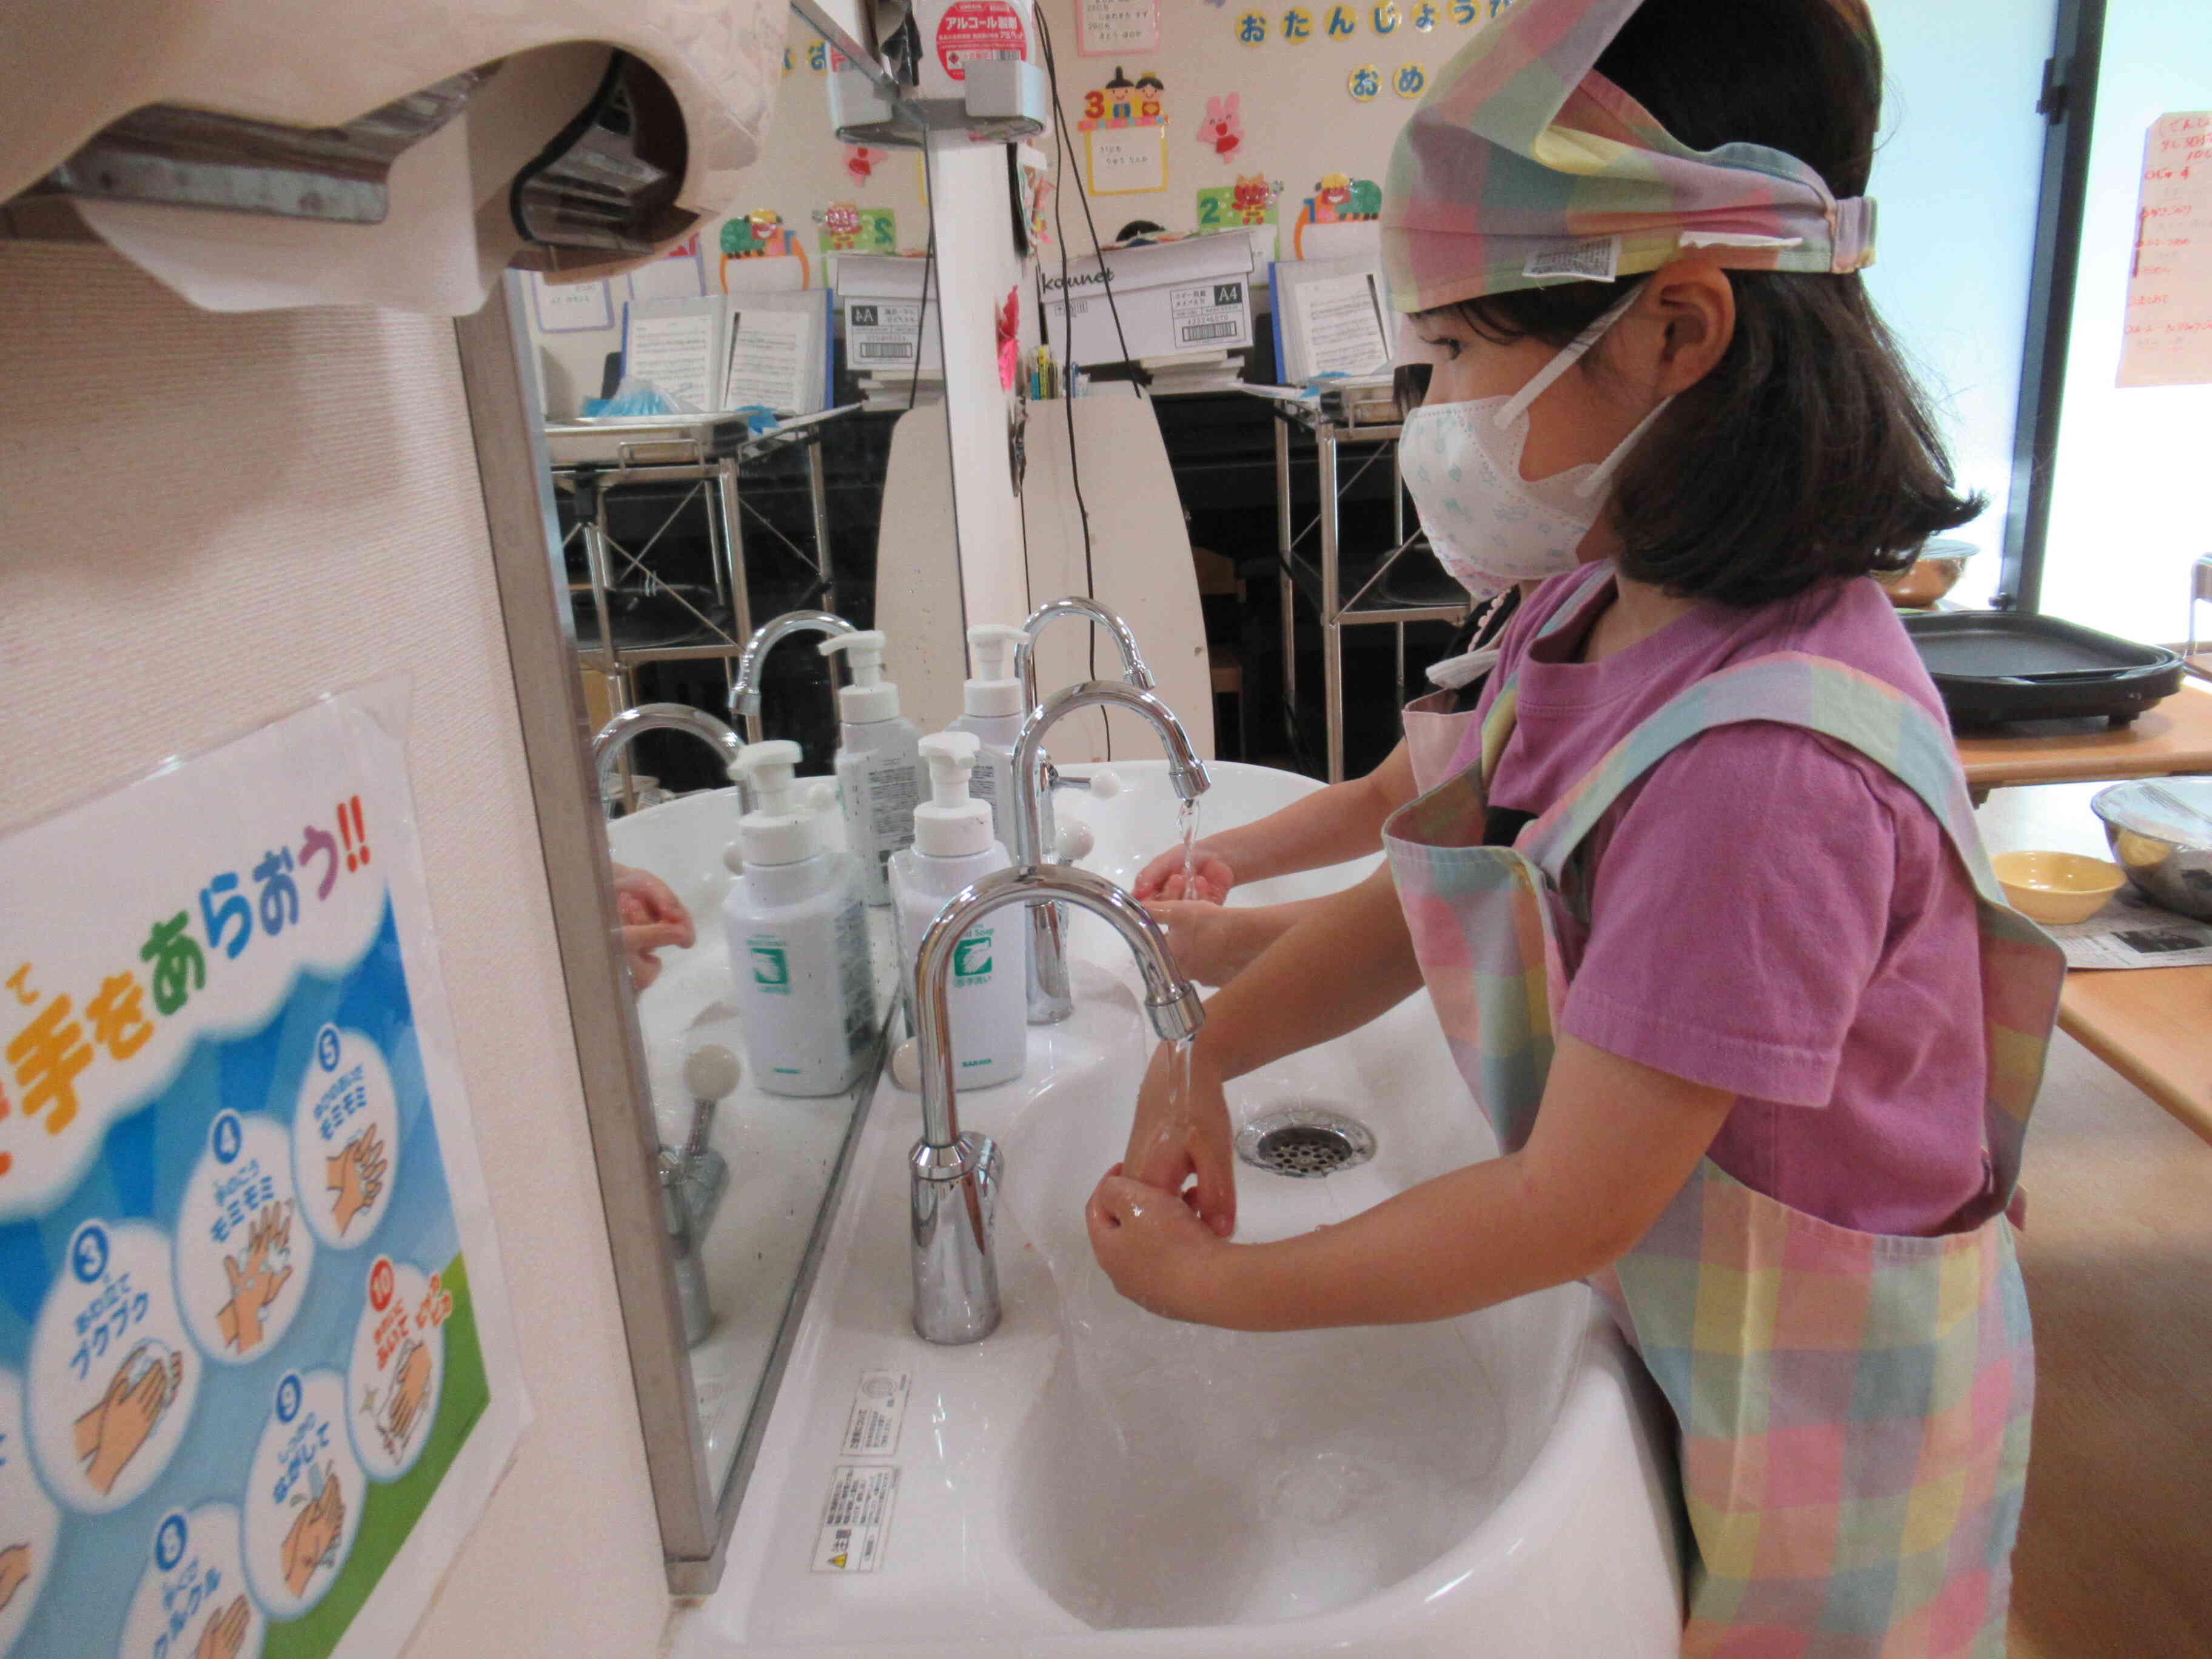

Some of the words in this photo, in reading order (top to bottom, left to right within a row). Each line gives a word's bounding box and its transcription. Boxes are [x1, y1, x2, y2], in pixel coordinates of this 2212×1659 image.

[1085, 92, 1105, 119] 3
[1201, 198, 1221, 224] 2
[1304, 198, 1316, 223] 1
[1219, 286, 1238, 303] A4
[210, 1176, 275, 1242] モミモミ
